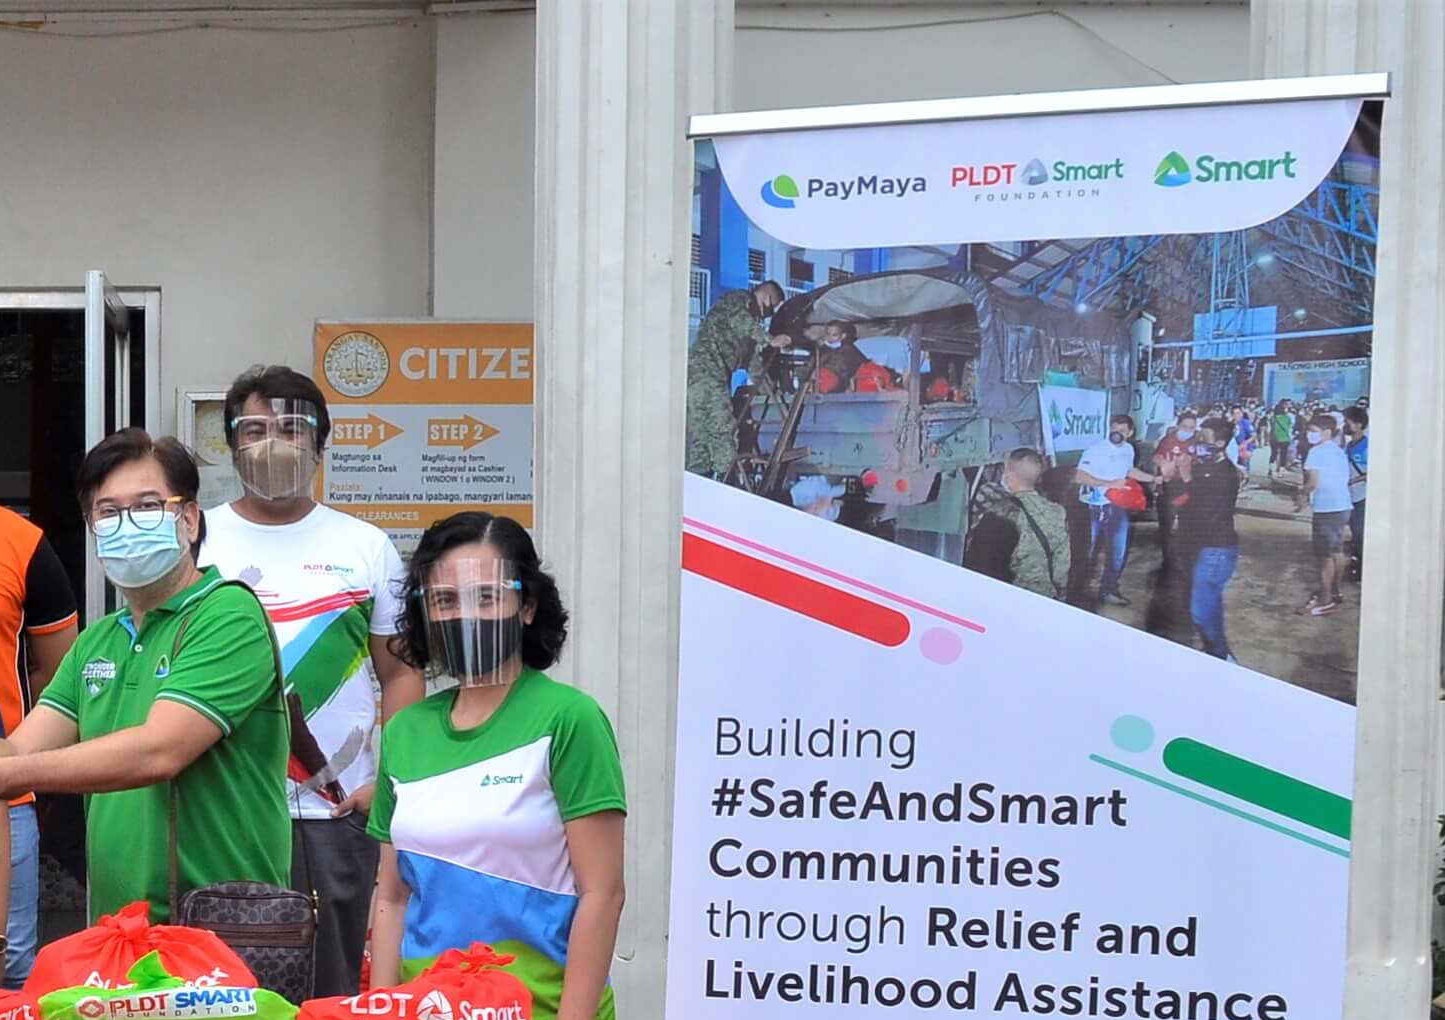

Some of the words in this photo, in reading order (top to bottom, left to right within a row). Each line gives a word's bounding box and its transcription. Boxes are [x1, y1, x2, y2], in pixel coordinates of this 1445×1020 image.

[951, 164, 1017, 188] PLDT
[1052, 158, 1125, 183] Smart
[1195, 151, 1298, 183] Smart
[807, 175, 928, 201] PayMaya
[974, 189, 1101, 203] FOUNDATION
[399, 347, 532, 380] CITIZE
[334, 424, 373, 440] STEP
[378, 424, 386, 440] 1
[430, 424, 469, 440] STEP
[473, 424, 484, 440] 2
[1063, 406, 1102, 437] Smart
[331, 453, 371, 462] Magtungo
[331, 464, 376, 473] Information
[378, 464, 398, 473] Desk
[330, 493, 352, 502] Kung
[355, 493, 372, 502] may
[464, 491, 504, 502] mangyari
[714, 717, 917, 769] Building
[710, 777, 1129, 828] #SafeAndSmart
[707, 838, 1062, 889] Communities
[705, 899, 906, 954] through
[926, 906, 1082, 953] Relief
[1095, 916, 1198, 957] and
[109, 993, 170, 1014] PLDT
[175, 988, 252, 1009] SMART
[704, 959, 977, 1013] Livelihood
